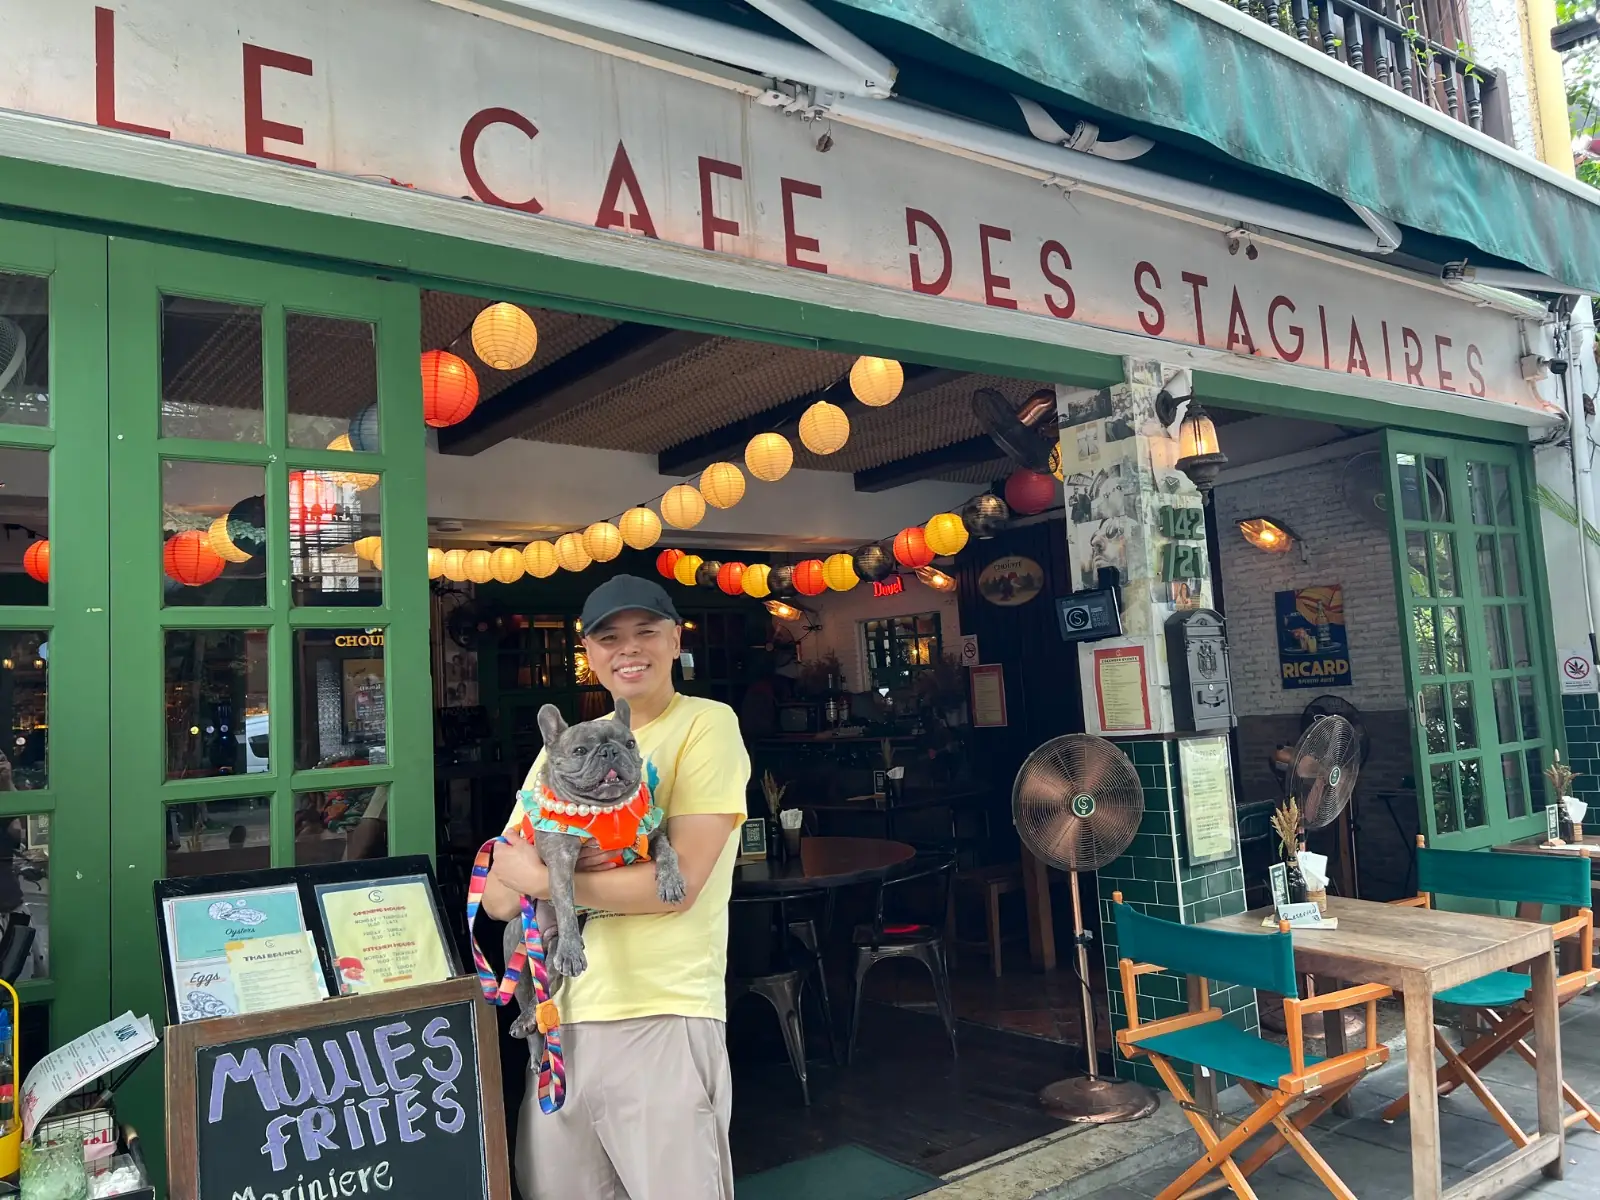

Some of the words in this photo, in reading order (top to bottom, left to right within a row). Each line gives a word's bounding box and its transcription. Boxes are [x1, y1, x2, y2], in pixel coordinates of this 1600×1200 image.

[95, 6, 316, 168] LE
[460, 106, 827, 274] CAFE
[905, 206, 1075, 318] DES
[1134, 261, 1485, 397] STAGIAIRES
[1160, 505, 1205, 540] 142
[873, 576, 903, 597] Duvel
[1282, 659, 1349, 678] RICARD
[225, 927, 256, 938] Oysters
[243, 954, 266, 962] THAI
[267, 949, 302, 959] BRUNCH
[189, 971, 221, 987] Eggs
[208, 1016, 463, 1124] MOULES
